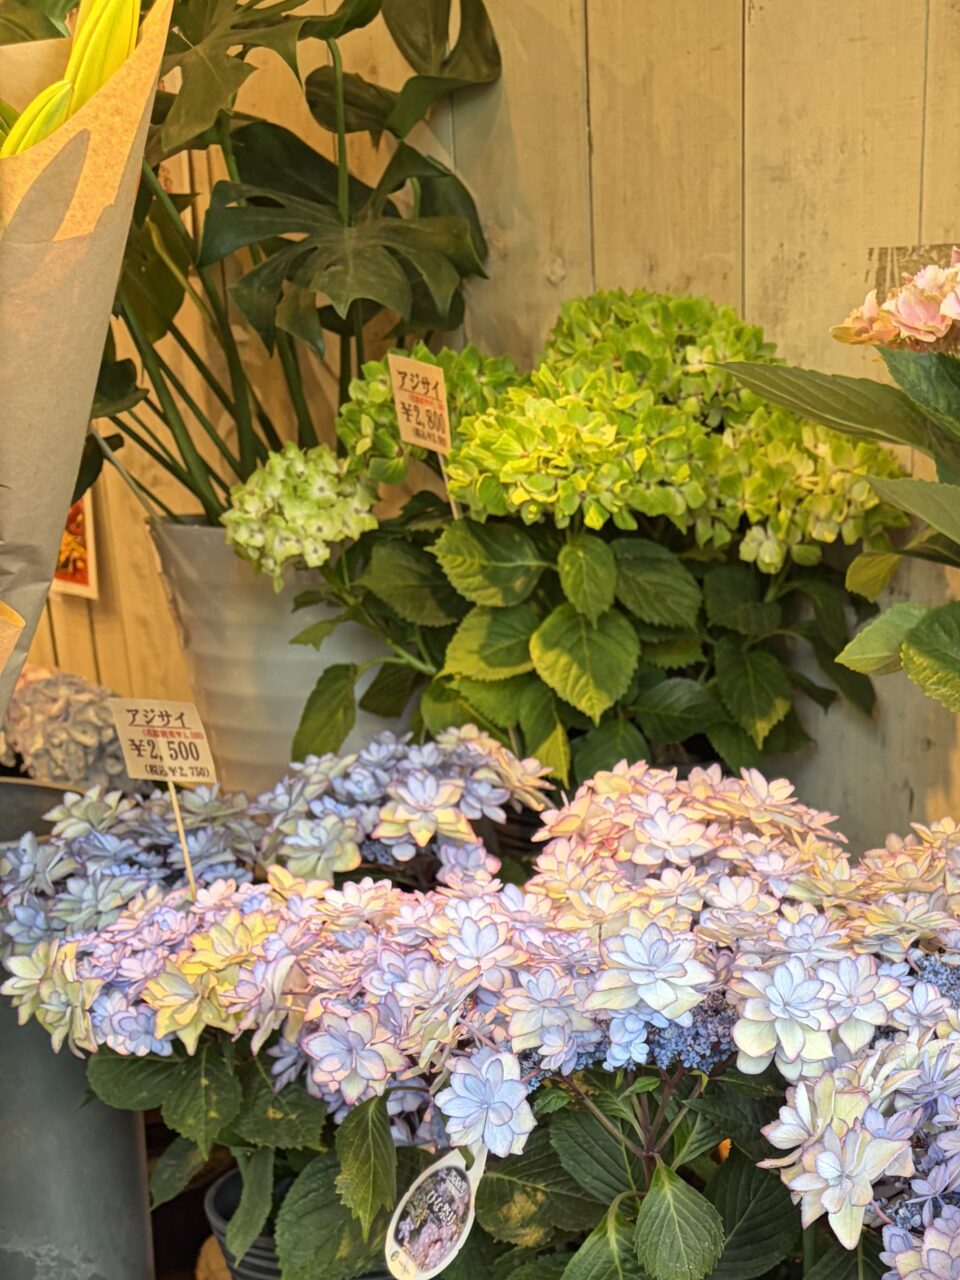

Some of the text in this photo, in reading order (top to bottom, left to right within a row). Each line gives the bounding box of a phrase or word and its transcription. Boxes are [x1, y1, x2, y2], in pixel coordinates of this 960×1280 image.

[397, 369, 440, 401] アジサイ
[126, 708, 186, 728] アジサイ
[128, 739, 200, 762] ¥2,500
